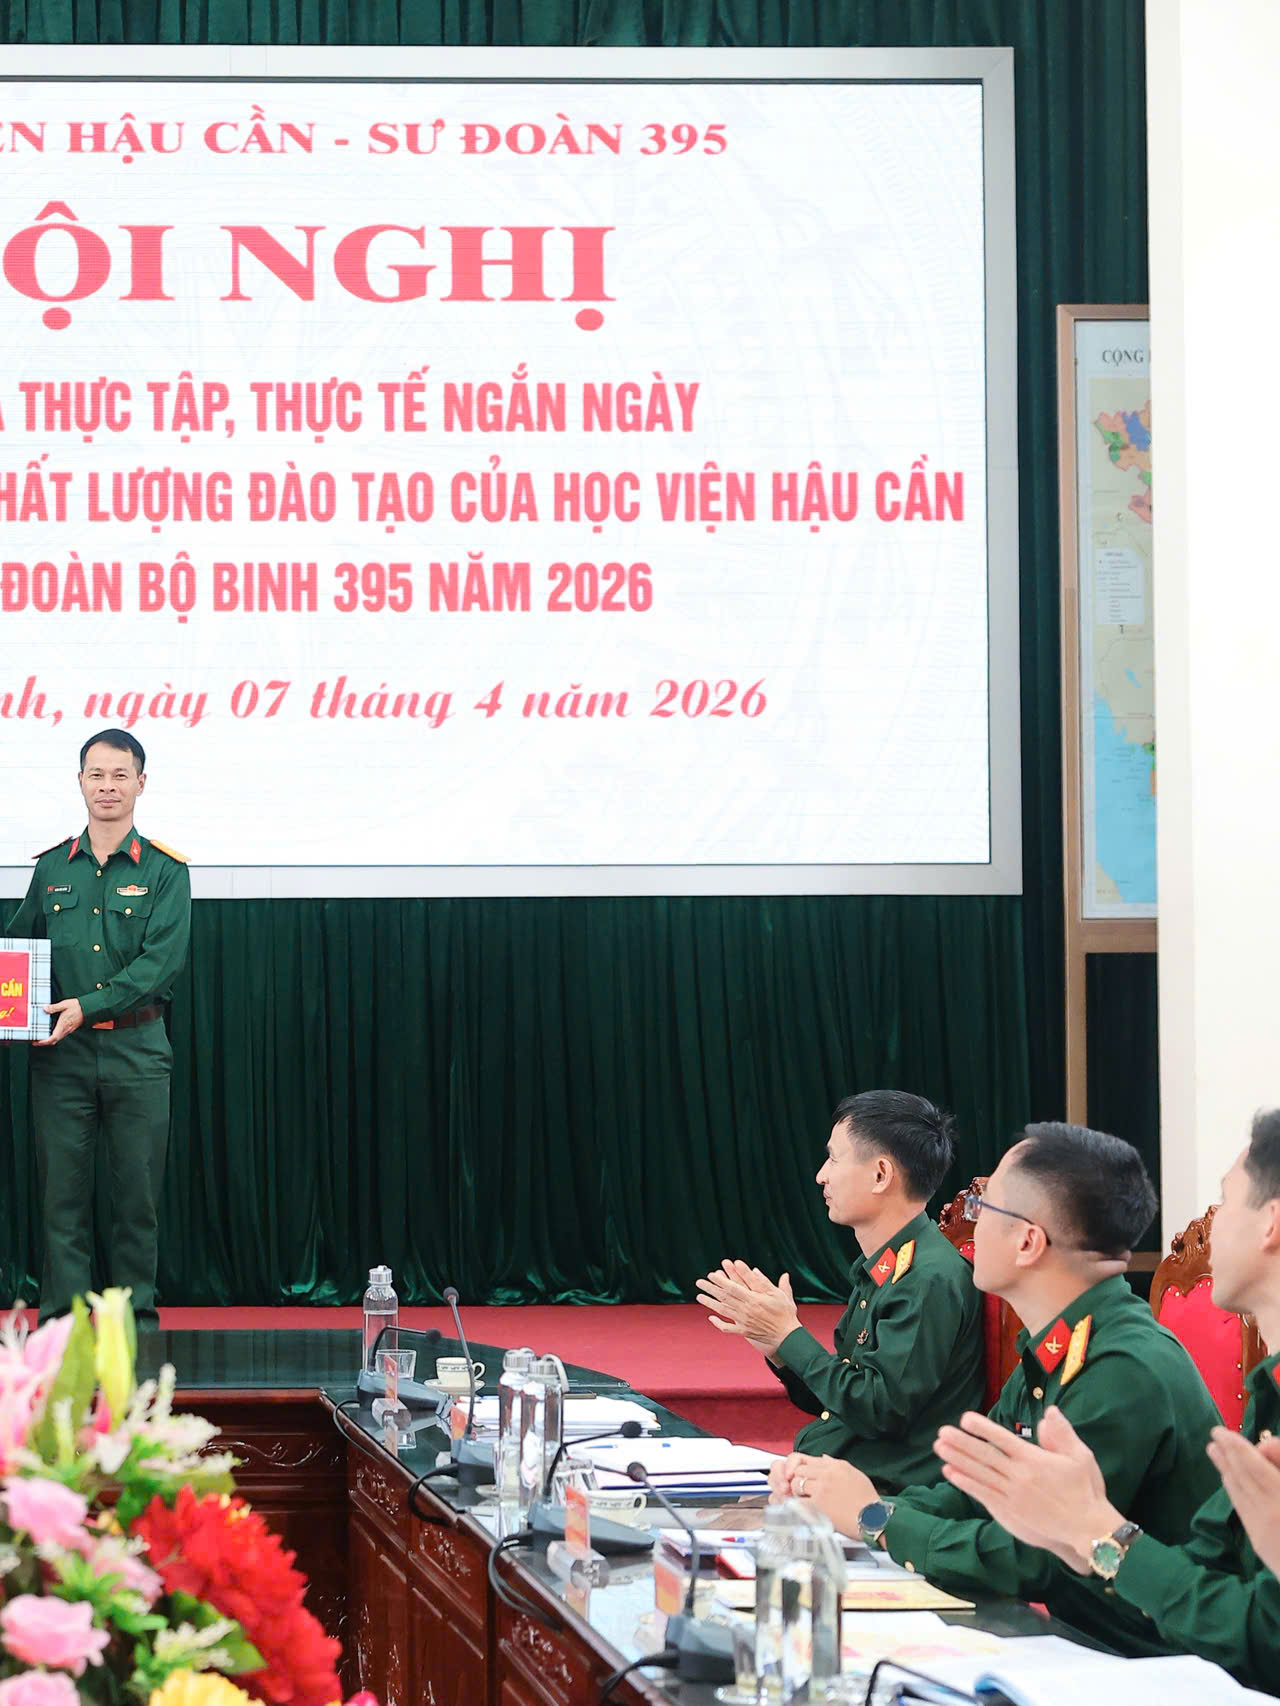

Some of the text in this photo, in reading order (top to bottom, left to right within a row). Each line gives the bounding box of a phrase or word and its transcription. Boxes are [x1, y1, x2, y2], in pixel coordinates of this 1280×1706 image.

[68, 112, 184, 164] HẬU
[204, 105, 314, 153] CẦN
[369, 119, 445, 154] SƯ
[461, 113, 622, 154] ĐOÀN
[640, 124, 727, 155] 395
[220, 224, 616, 332] NGHỊ
[19, 376, 131, 443] THỰC
[147, 371, 234, 443] TẬP,
[250, 377, 362, 443] THỰC
[378, 366, 430, 432] TẾ
[444, 363, 566, 432] NGẮN
[584, 371, 699, 432] NGÀY
[88, 467, 232, 533] LƯỢNG
[248, 461, 336, 522] ĐÀO
[352, 472, 434, 533] TẠO
[451, 455, 538, 522] CỦA
[554, 472, 640, 533] HỌC
[656, 461, 755, 532] VIỆN
[772, 461, 858, 532] HẬU
[875, 454, 964, 522] CẦN
[0, 551, 122, 612] ĐOÀN
[140, 551, 196, 623] BỘ
[213, 562, 317, 611] BINH
[334, 562, 412, 612] 395
[429, 552, 530, 611] NĂM
[547, 562, 652, 612] 2026
[84, 682, 208, 729] ngày
[231, 679, 290, 718] 07
[311, 676, 452, 729] tháng
[474, 681, 504, 718] 4
[522, 680, 628, 718] năm
[650, 679, 767, 718] 2026
